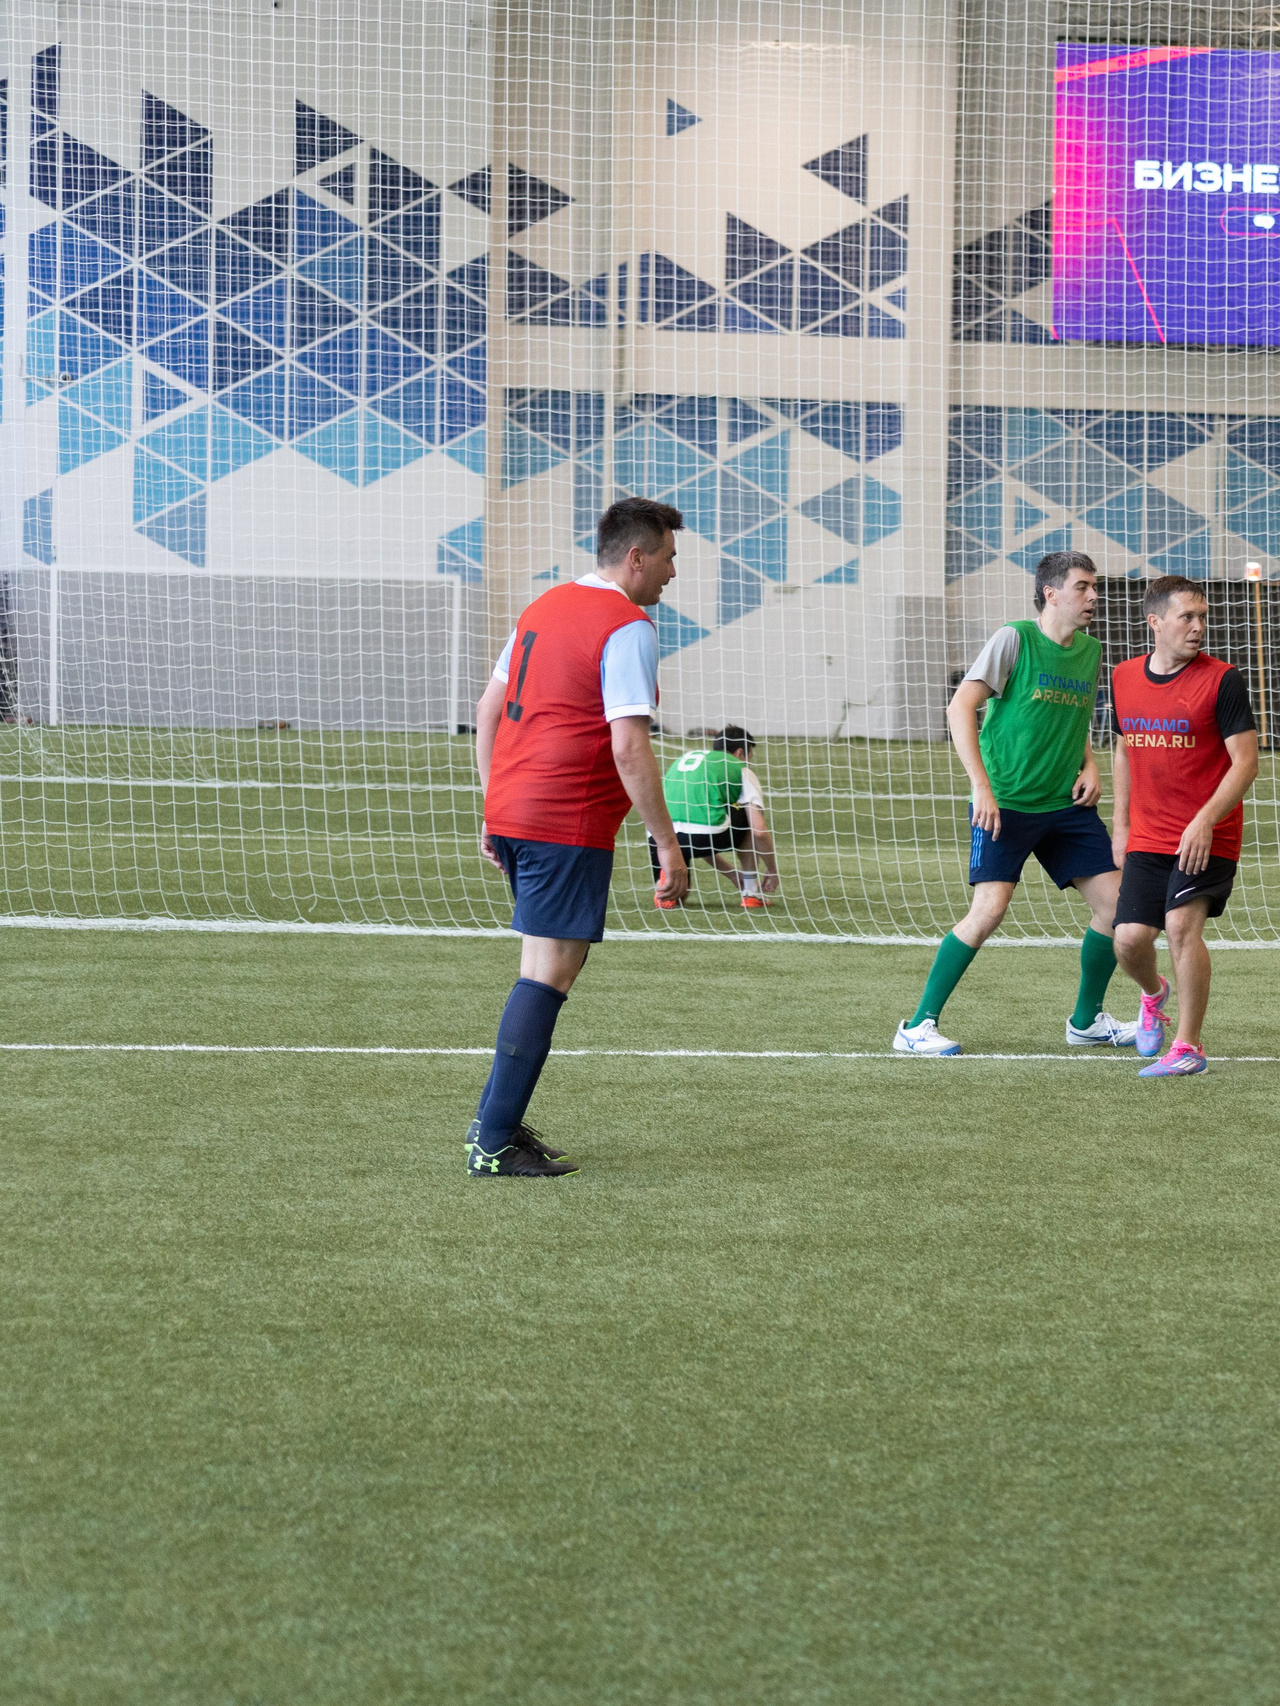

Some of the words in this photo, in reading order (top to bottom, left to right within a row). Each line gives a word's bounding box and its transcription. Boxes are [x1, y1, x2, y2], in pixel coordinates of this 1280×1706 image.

[506, 630, 538, 722] 1
[1038, 673, 1092, 694] DYNAMO
[1031, 688, 1090, 708] ARENA.R
[1122, 718, 1190, 733] DYNAMO
[677, 750, 711, 772] 6
